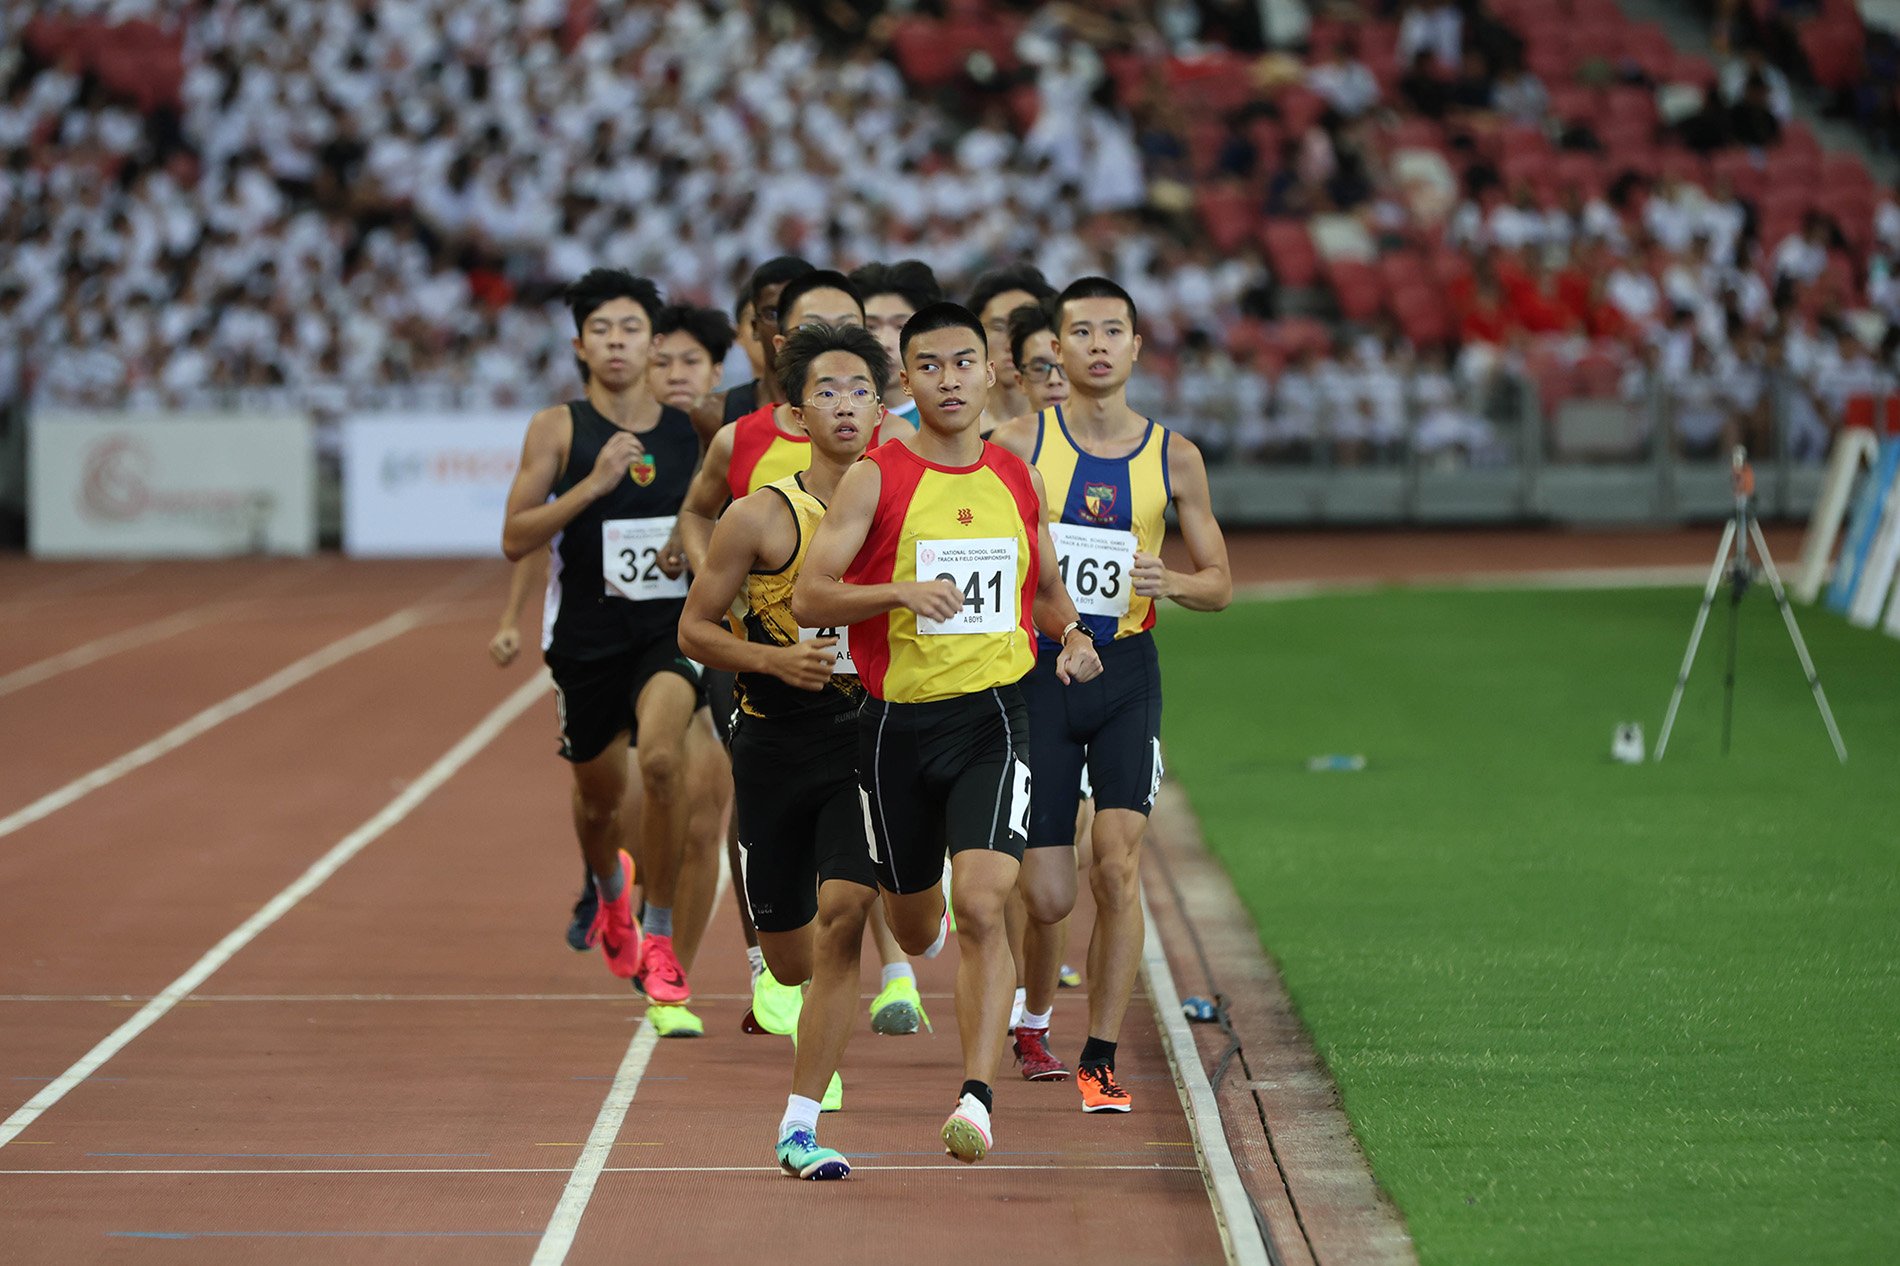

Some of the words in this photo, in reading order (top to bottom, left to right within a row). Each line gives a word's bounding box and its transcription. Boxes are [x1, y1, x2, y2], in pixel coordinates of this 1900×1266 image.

[1094, 544, 1129, 552] CHAMPIONSHIPS
[620, 548, 659, 583] 32
[1058, 555, 1121, 599] 163
[1080, 597, 1094, 605] BOYS
